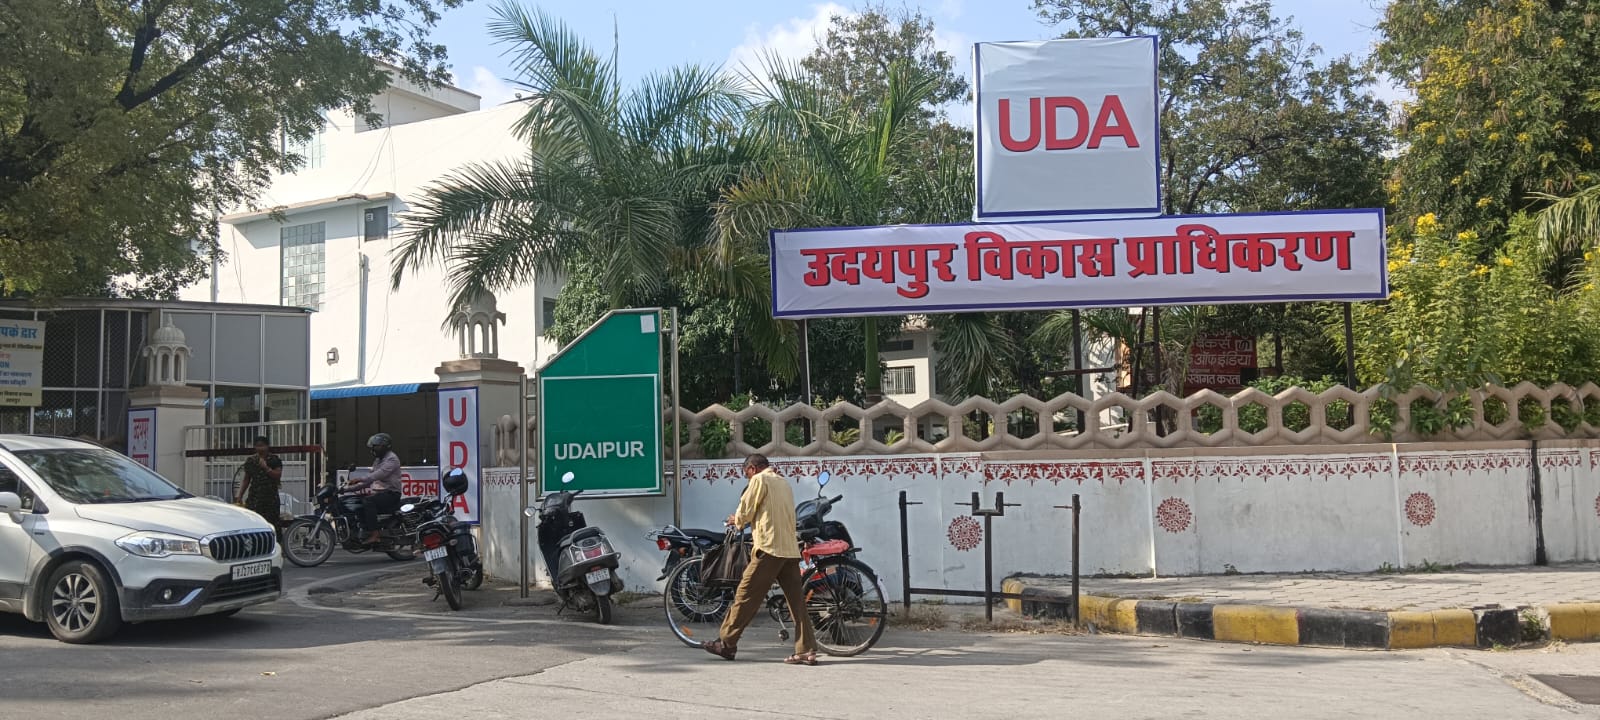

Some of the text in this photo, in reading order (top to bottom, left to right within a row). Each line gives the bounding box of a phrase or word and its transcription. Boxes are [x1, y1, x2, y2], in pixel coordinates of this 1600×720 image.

[998, 95, 1140, 152] UDA
[800, 224, 1355, 298] उदयपुर विकास प्राधिकरण
[1217, 350, 1252, 367] इंडिया
[1187, 374, 1216, 386] स्वागत
[554, 441, 645, 460] UDAIPUR
